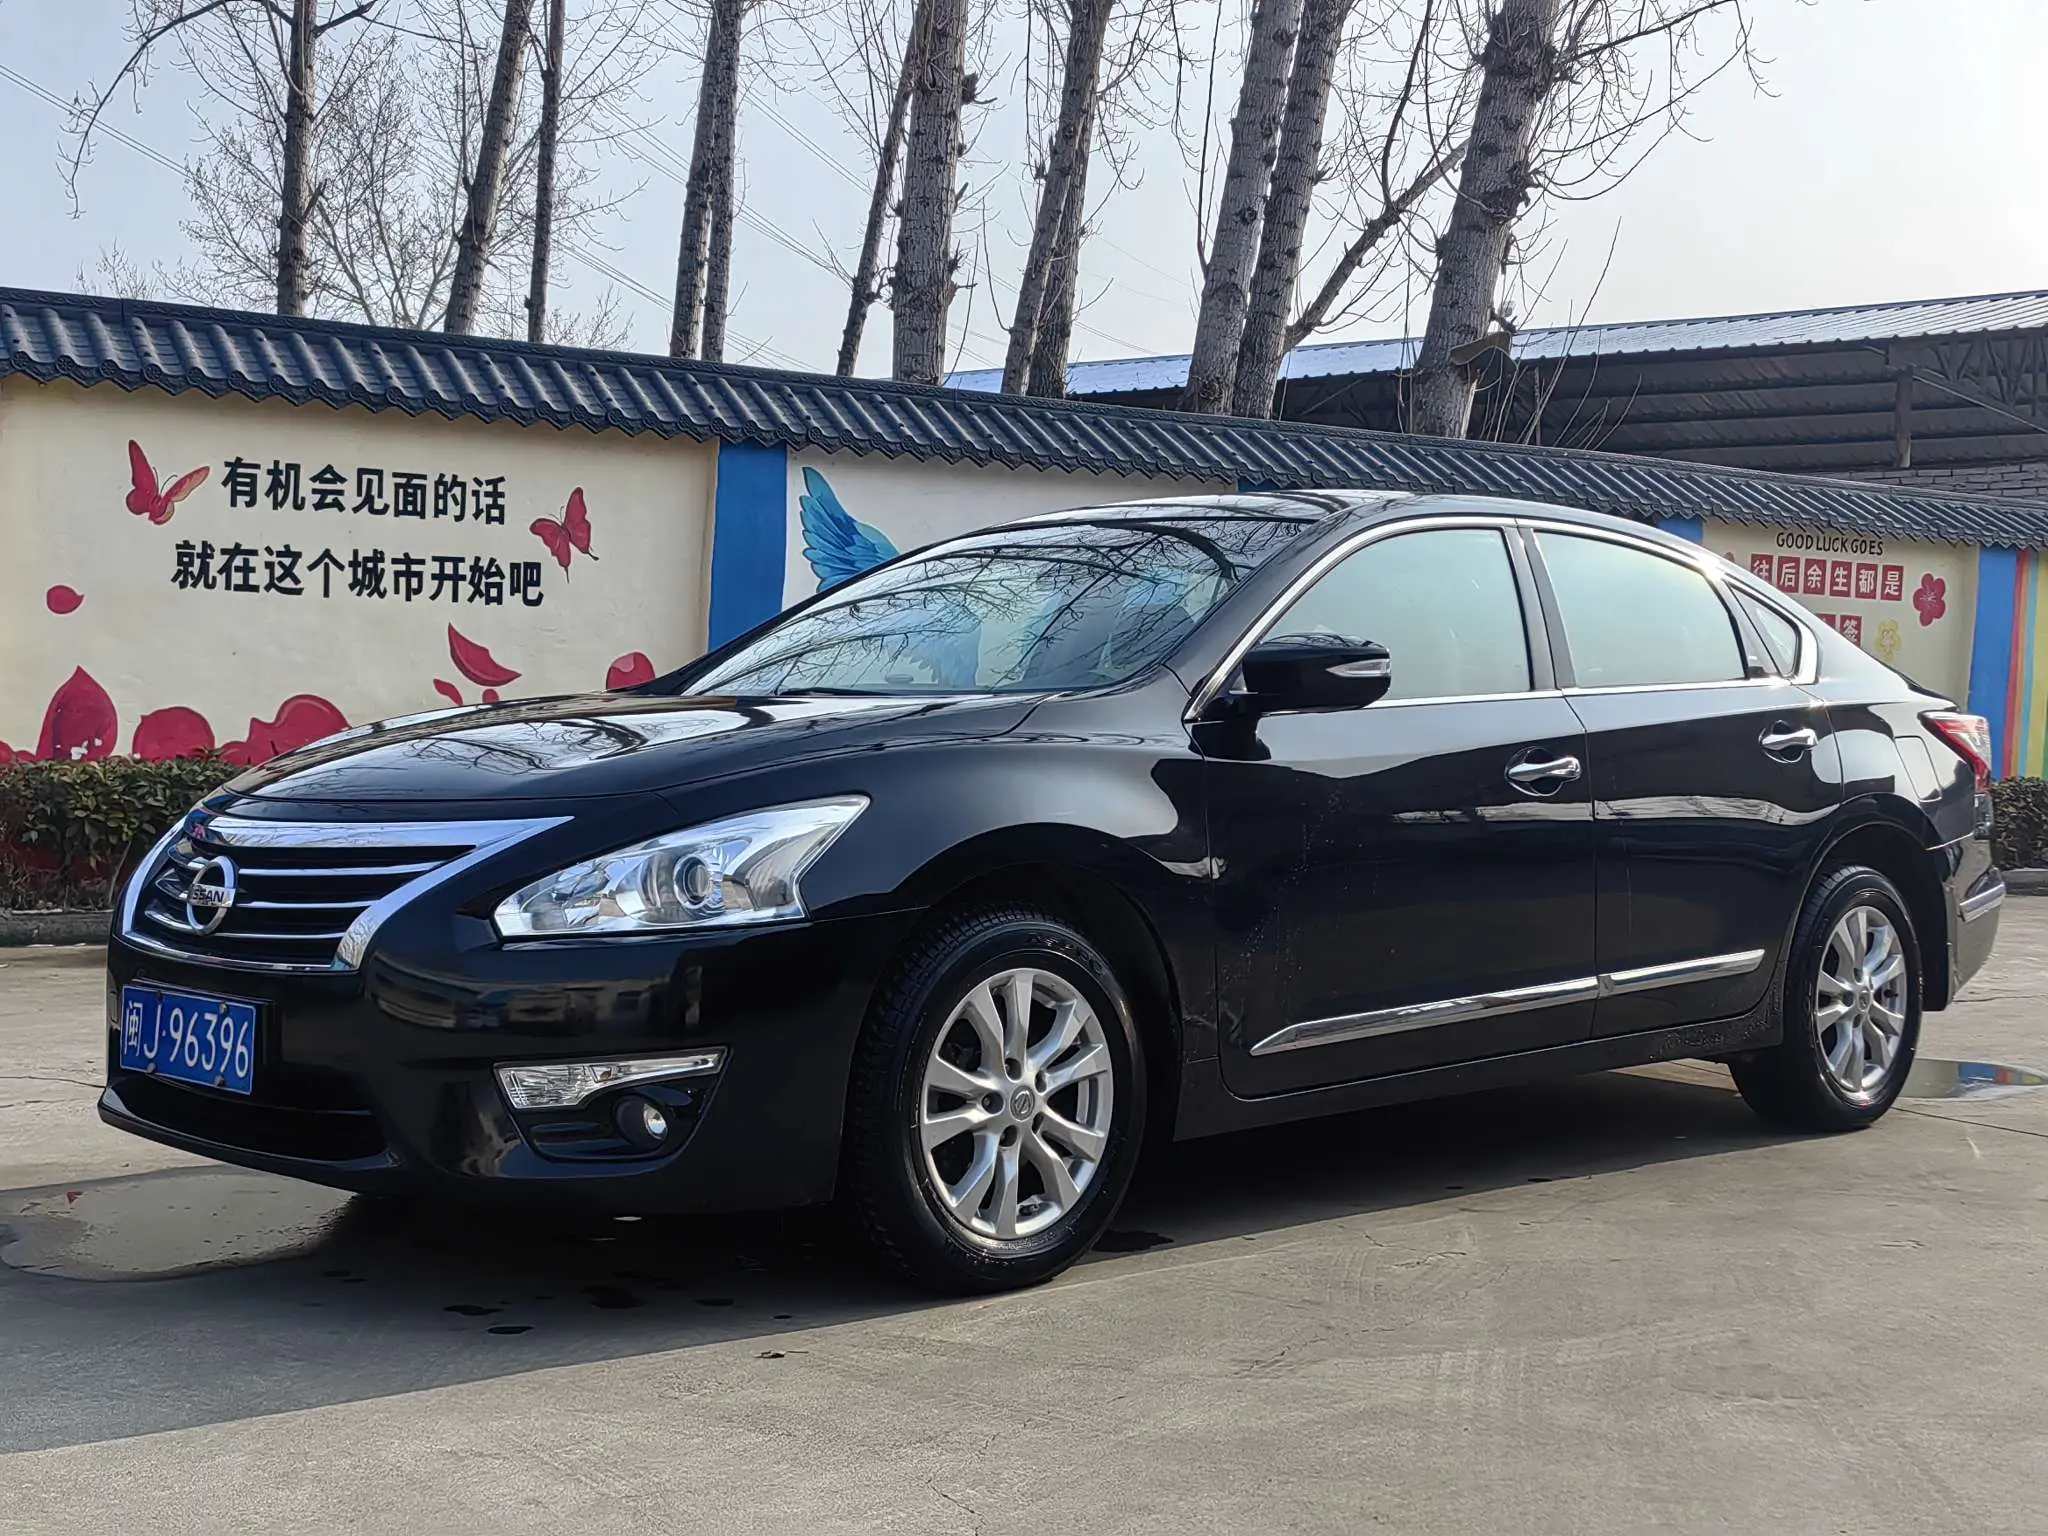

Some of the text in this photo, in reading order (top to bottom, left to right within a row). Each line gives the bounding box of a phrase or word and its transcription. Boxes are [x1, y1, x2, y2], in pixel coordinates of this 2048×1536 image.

[220, 456, 507, 526] 有机会见面的话
[1776, 532, 1884, 556] GOOD LUCK GOES
[171, 540, 545, 607] 就在这个城市开始吧
[1752, 559, 1901, 596] 往后余生都是
